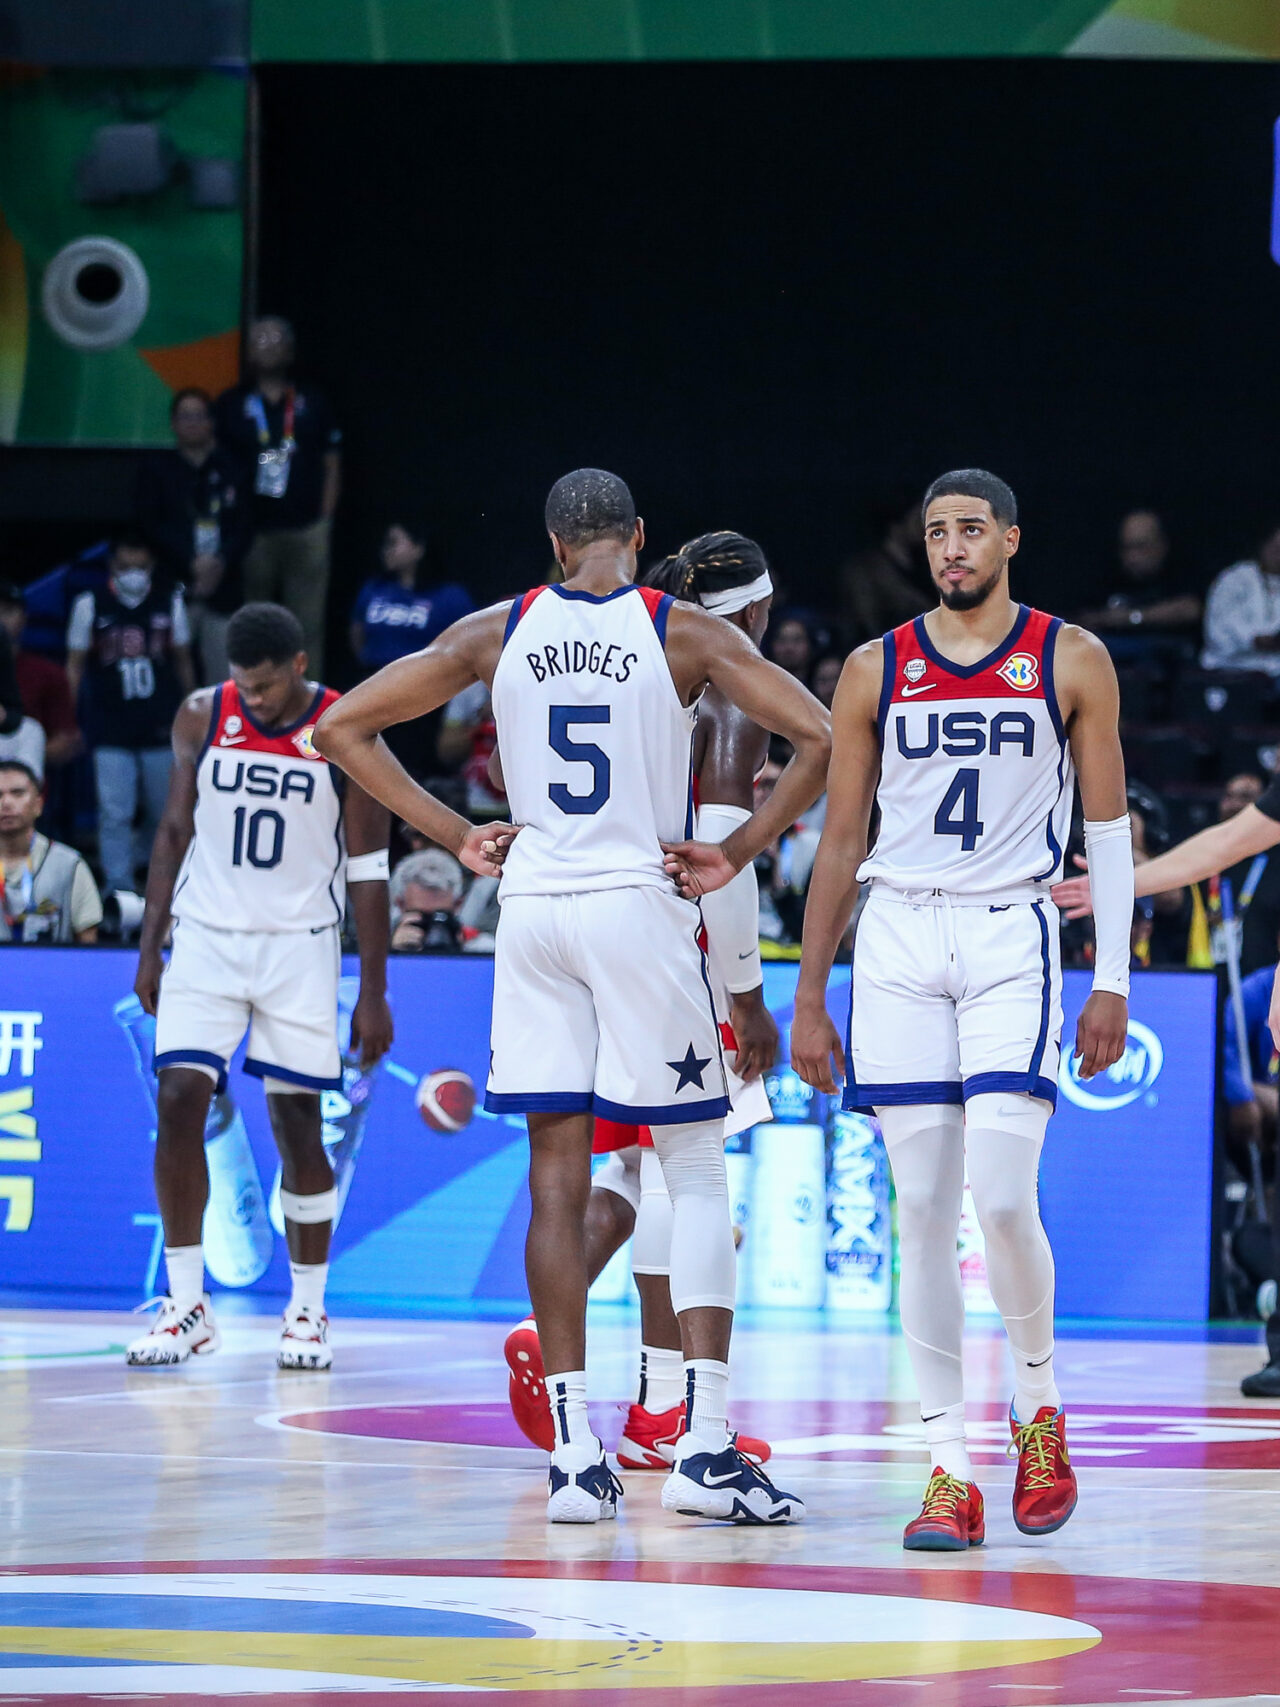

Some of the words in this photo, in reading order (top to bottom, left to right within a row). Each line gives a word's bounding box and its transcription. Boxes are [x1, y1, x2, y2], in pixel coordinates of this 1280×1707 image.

[526, 640, 638, 683] BRIDGES
[549, 704, 610, 815] 5
[895, 711, 1035, 760] USA
[212, 759, 315, 804] USA
[233, 806, 285, 868] 10
[934, 768, 984, 851] 4
